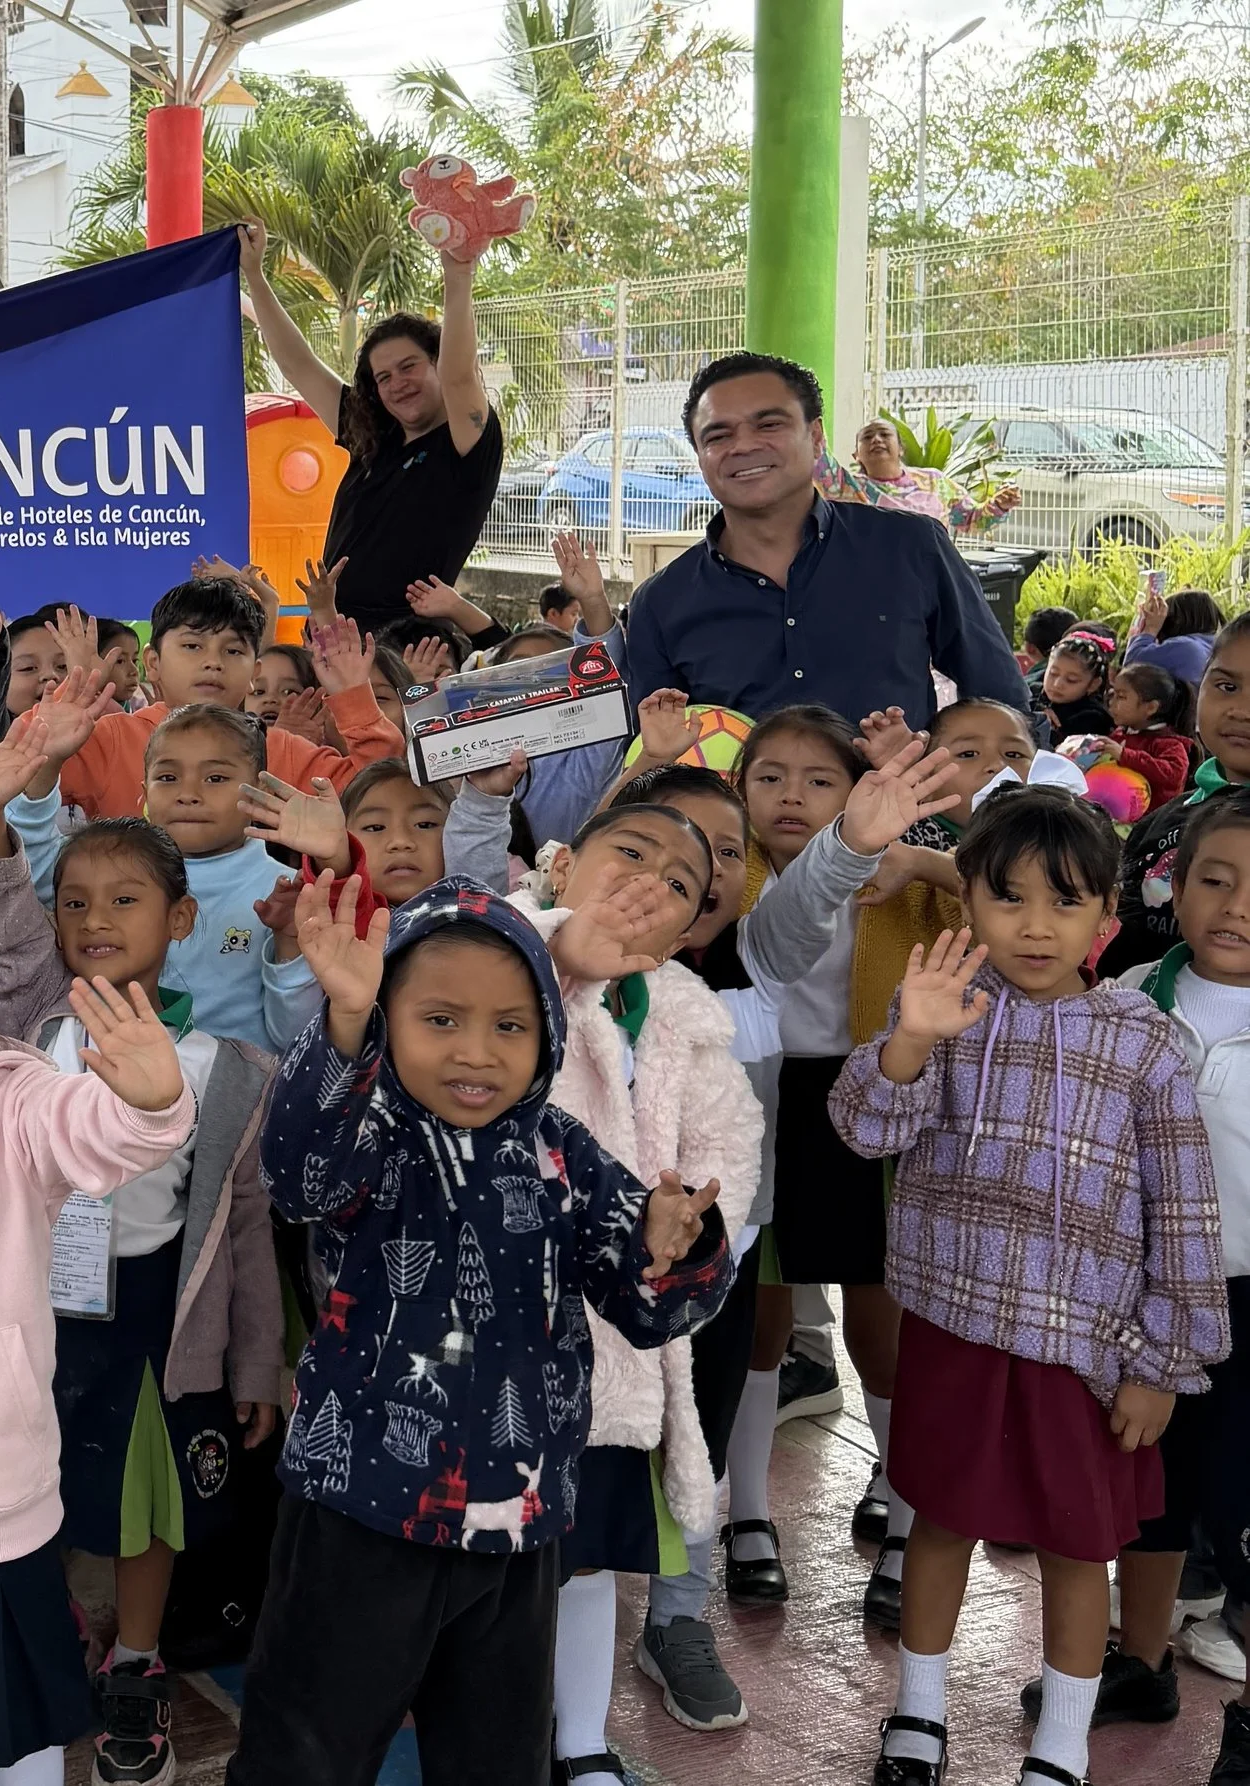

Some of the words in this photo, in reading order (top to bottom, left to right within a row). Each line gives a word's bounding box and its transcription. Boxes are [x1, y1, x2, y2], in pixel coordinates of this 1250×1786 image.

[20, 504, 93, 525] Hoteles
[99, 503, 122, 524] de
[128, 503, 206, 527] Cancún,
[53, 528, 68, 547] &
[75, 527, 107, 546] Isla
[114, 526, 191, 549] Mujeres
[489, 692, 527, 709] CATAPULT
[528, 687, 561, 699] TRAILER
